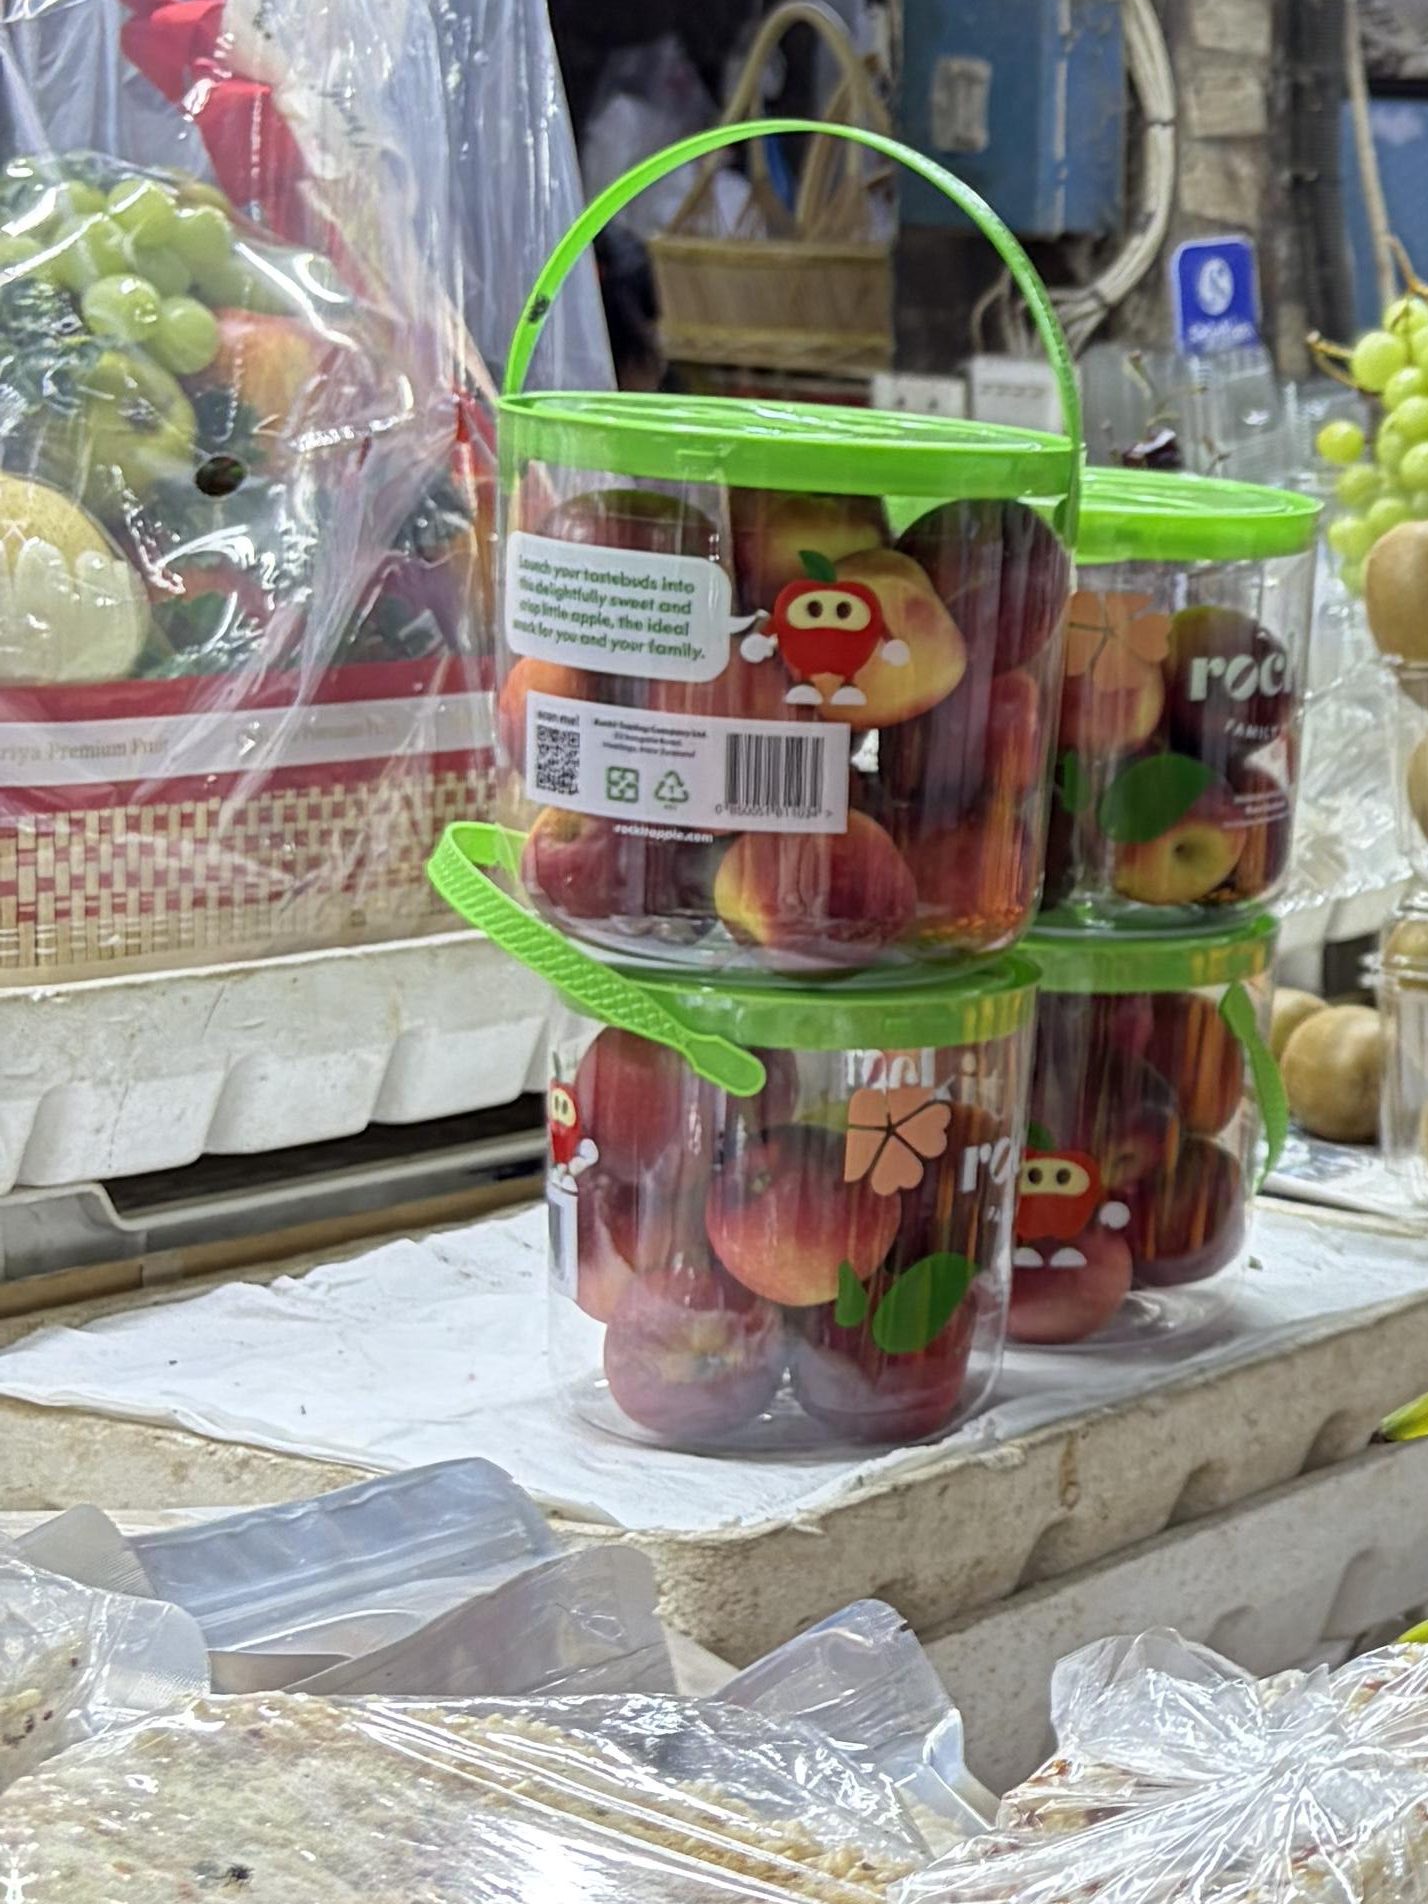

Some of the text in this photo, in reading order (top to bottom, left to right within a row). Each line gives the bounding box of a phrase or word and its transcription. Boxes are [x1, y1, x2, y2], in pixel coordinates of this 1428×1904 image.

[552, 564, 581, 583] your
[583, 569, 658, 591] tastebuds
[661, 577, 696, 594] into
[535, 577, 607, 607] delightfully
[610, 595, 654, 610] sweet
[658, 600, 692, 615] and
[570, 610, 615, 630] apple,
[618, 613, 644, 632] the
[647, 618, 690, 637] ideal
[555, 628, 577, 645] you
[580, 633, 608, 648] and
[610, 639, 645, 653] your
[648, 642, 707, 661] family.
